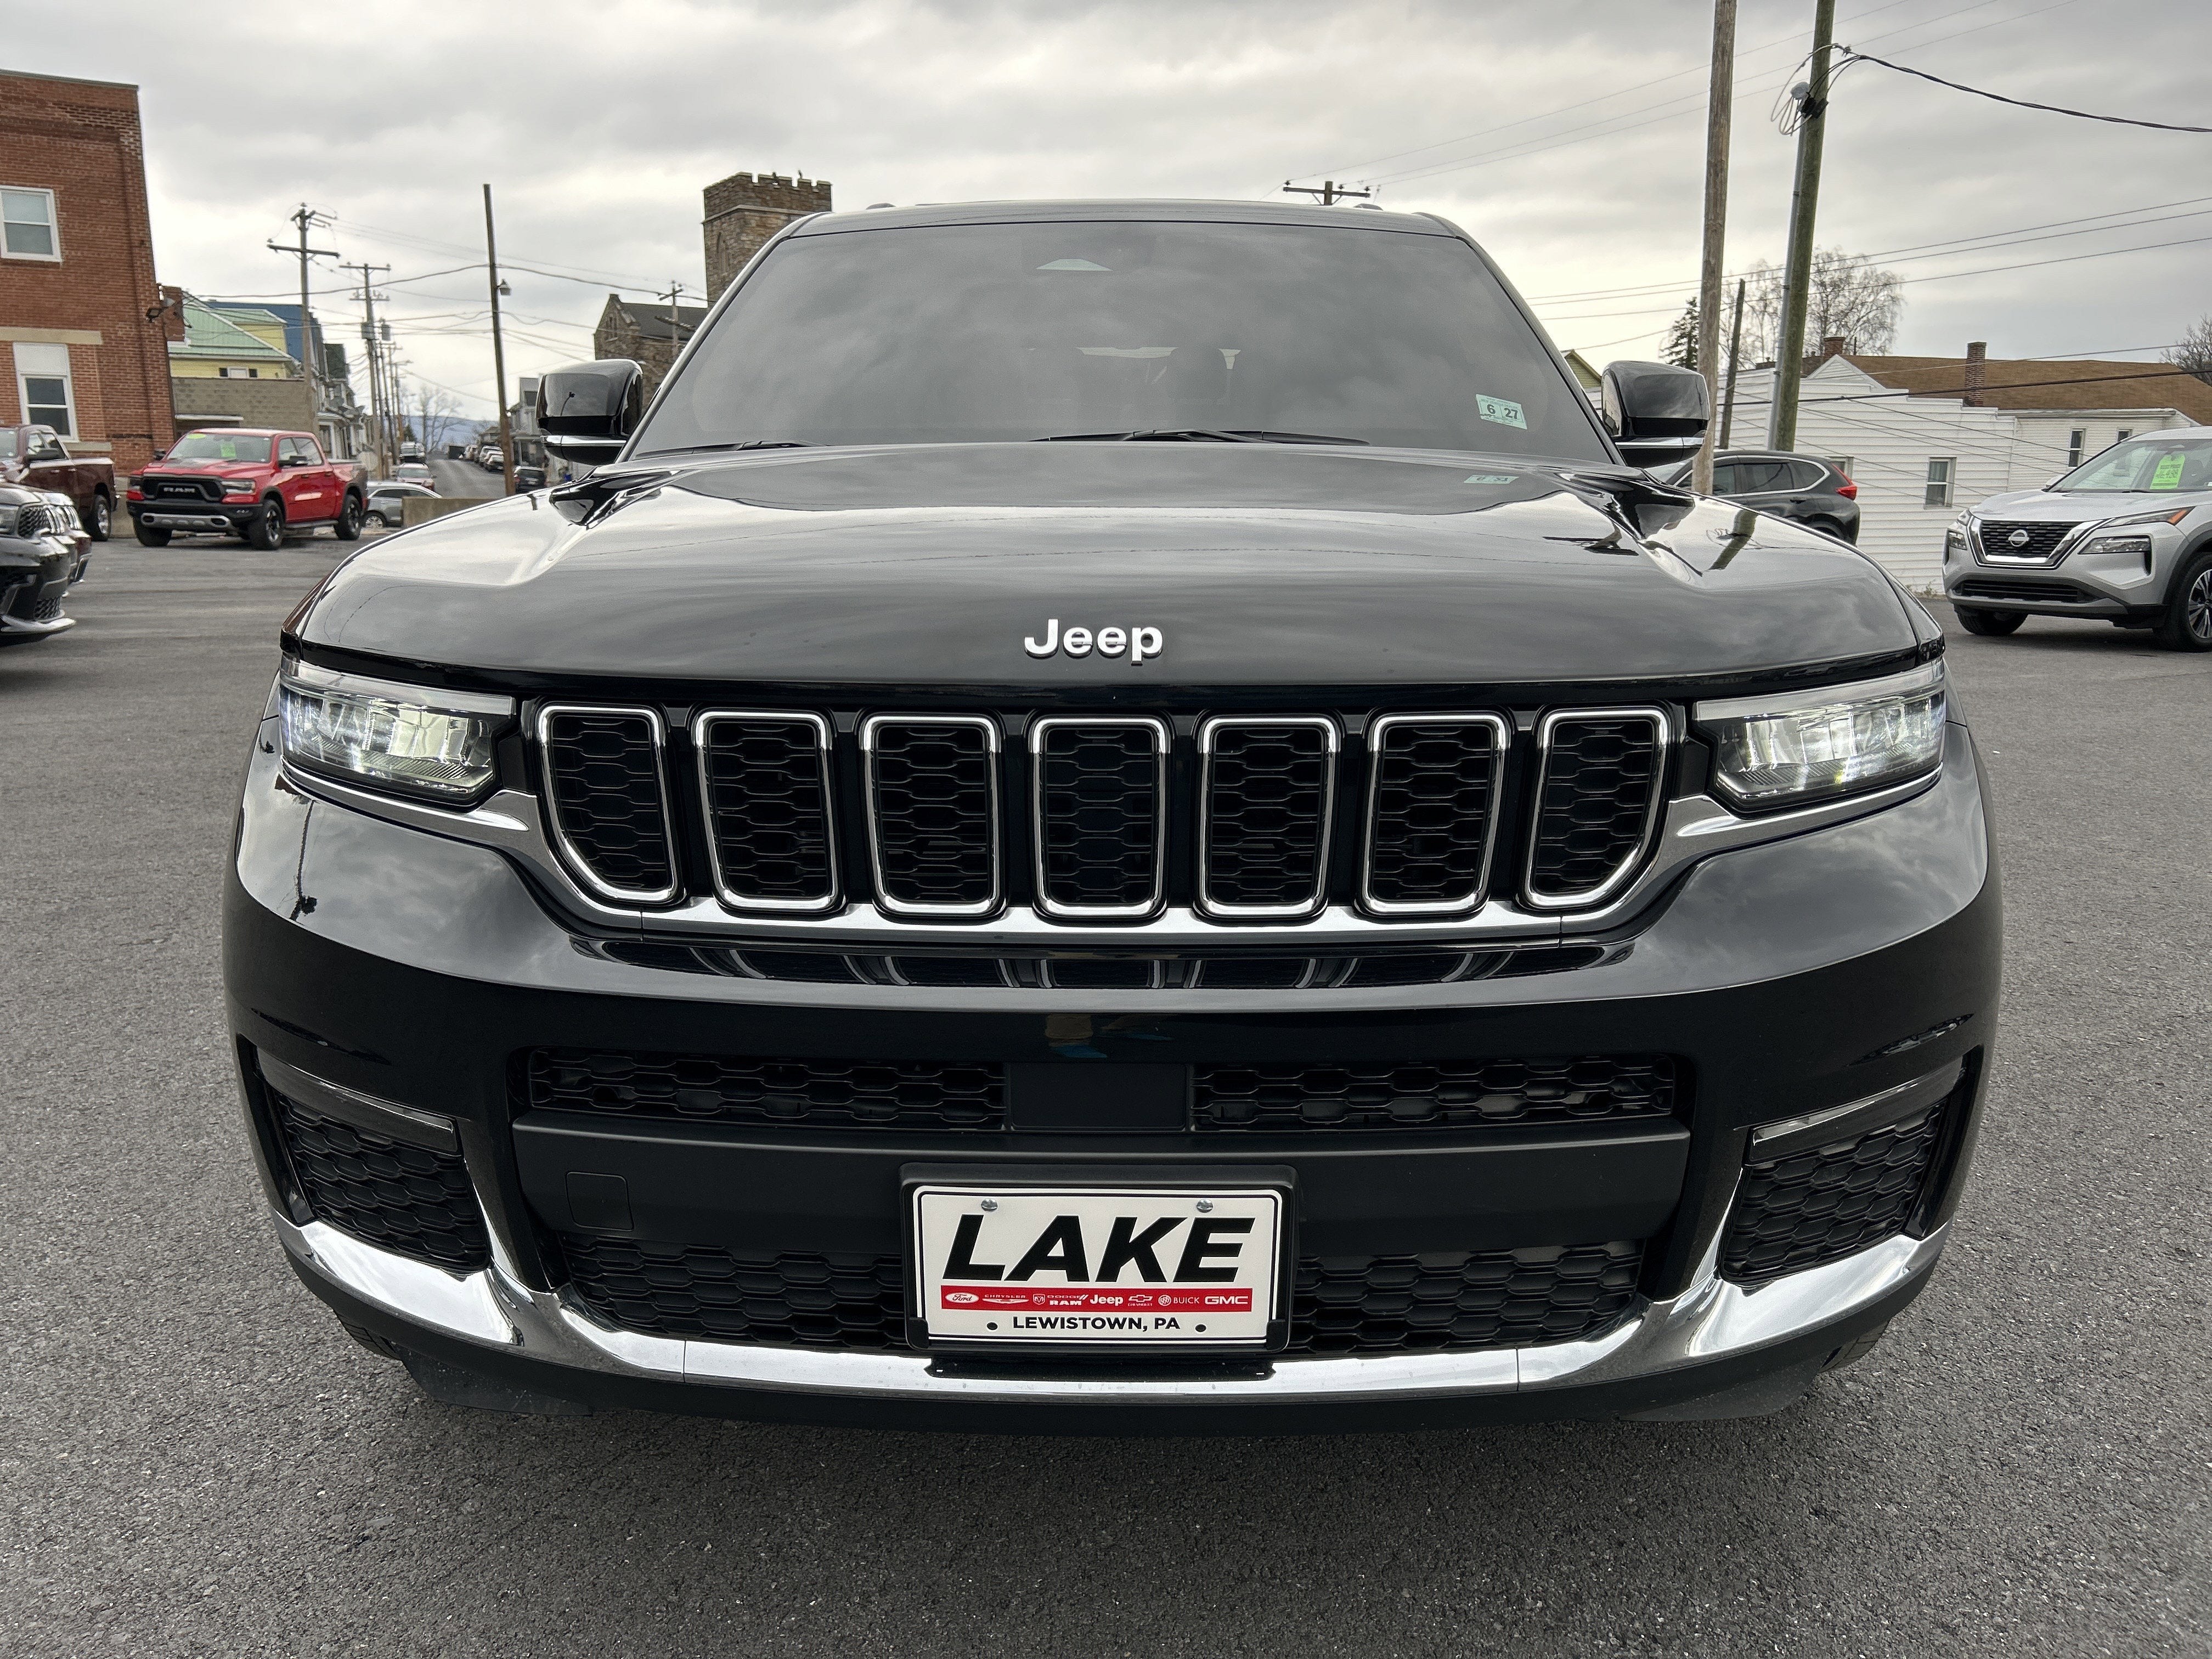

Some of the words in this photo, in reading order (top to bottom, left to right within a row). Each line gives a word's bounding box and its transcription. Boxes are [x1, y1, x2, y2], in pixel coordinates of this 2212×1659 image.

[1487, 404, 1496, 414] 6
[1504, 408, 1518, 420] 27
[1024, 618, 1164, 667] Jeep
[942, 1214, 1256, 1283] LAKE
[1090, 1294, 1124, 1306] Jeep
[1204, 1296, 1249, 1305] GMC
[1013, 1316, 1148, 1332] LEWISTOWN,
[1154, 1317, 1181, 1329] PA
